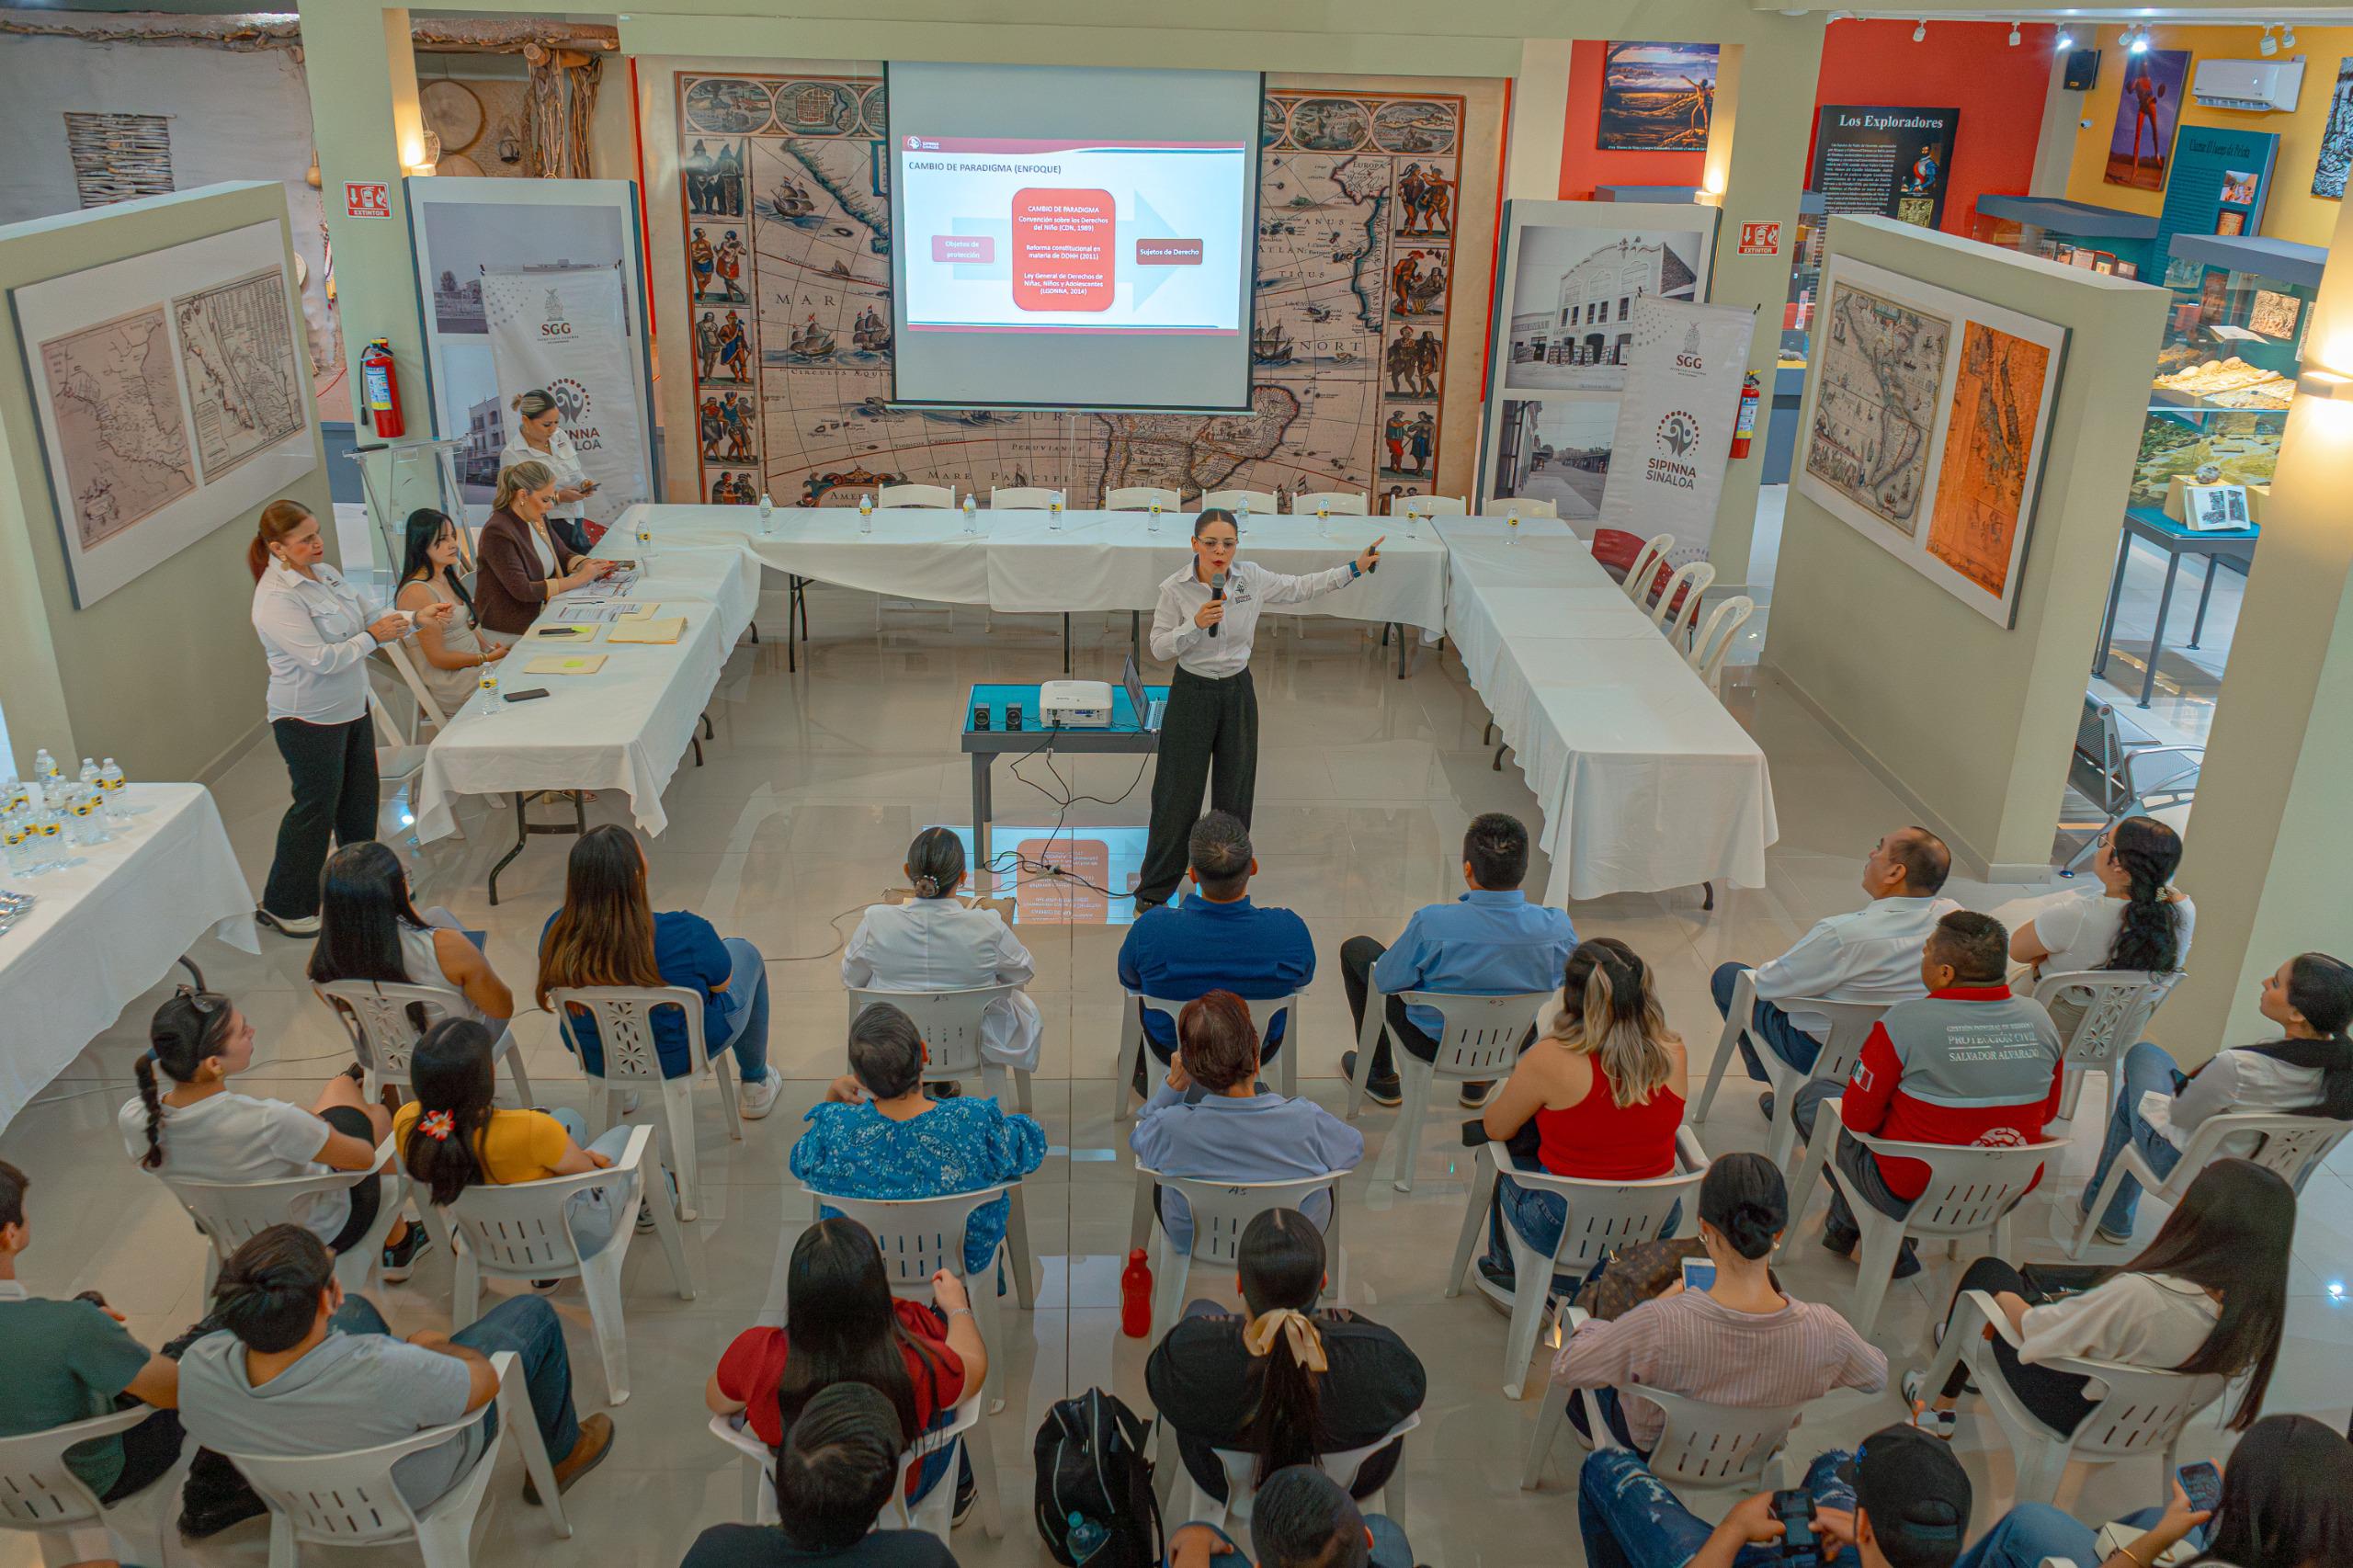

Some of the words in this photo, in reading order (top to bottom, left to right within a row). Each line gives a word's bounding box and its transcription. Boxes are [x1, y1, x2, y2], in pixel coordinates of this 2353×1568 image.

[1839, 115, 1861, 127] Los
[1864, 115, 1944, 130] Exploradores
[909, 161, 944, 170] CAMBIO
[947, 163, 957, 171] DE
[960, 164, 1012, 173] PARADIGMA
[1014, 165, 1062, 175] (ENFOQUE)
[775, 294, 836, 306] MAR
[541, 323, 572, 336] SGG
[1299, 341, 1362, 352] NORT
[1676, 354, 1702, 369] SGG
[1648, 457, 1697, 478] SIPINNA
[927, 471, 972, 479] MARE
[1646, 469, 1694, 491] SINALOA
[1948, 1031, 2013, 1045] PROTECCIÓN
[2014, 1032, 2037, 1043] CIVIL
[1949, 1051, 1997, 1062] SALVADOR
[1998, 1048, 2039, 1060] ALVARADO
